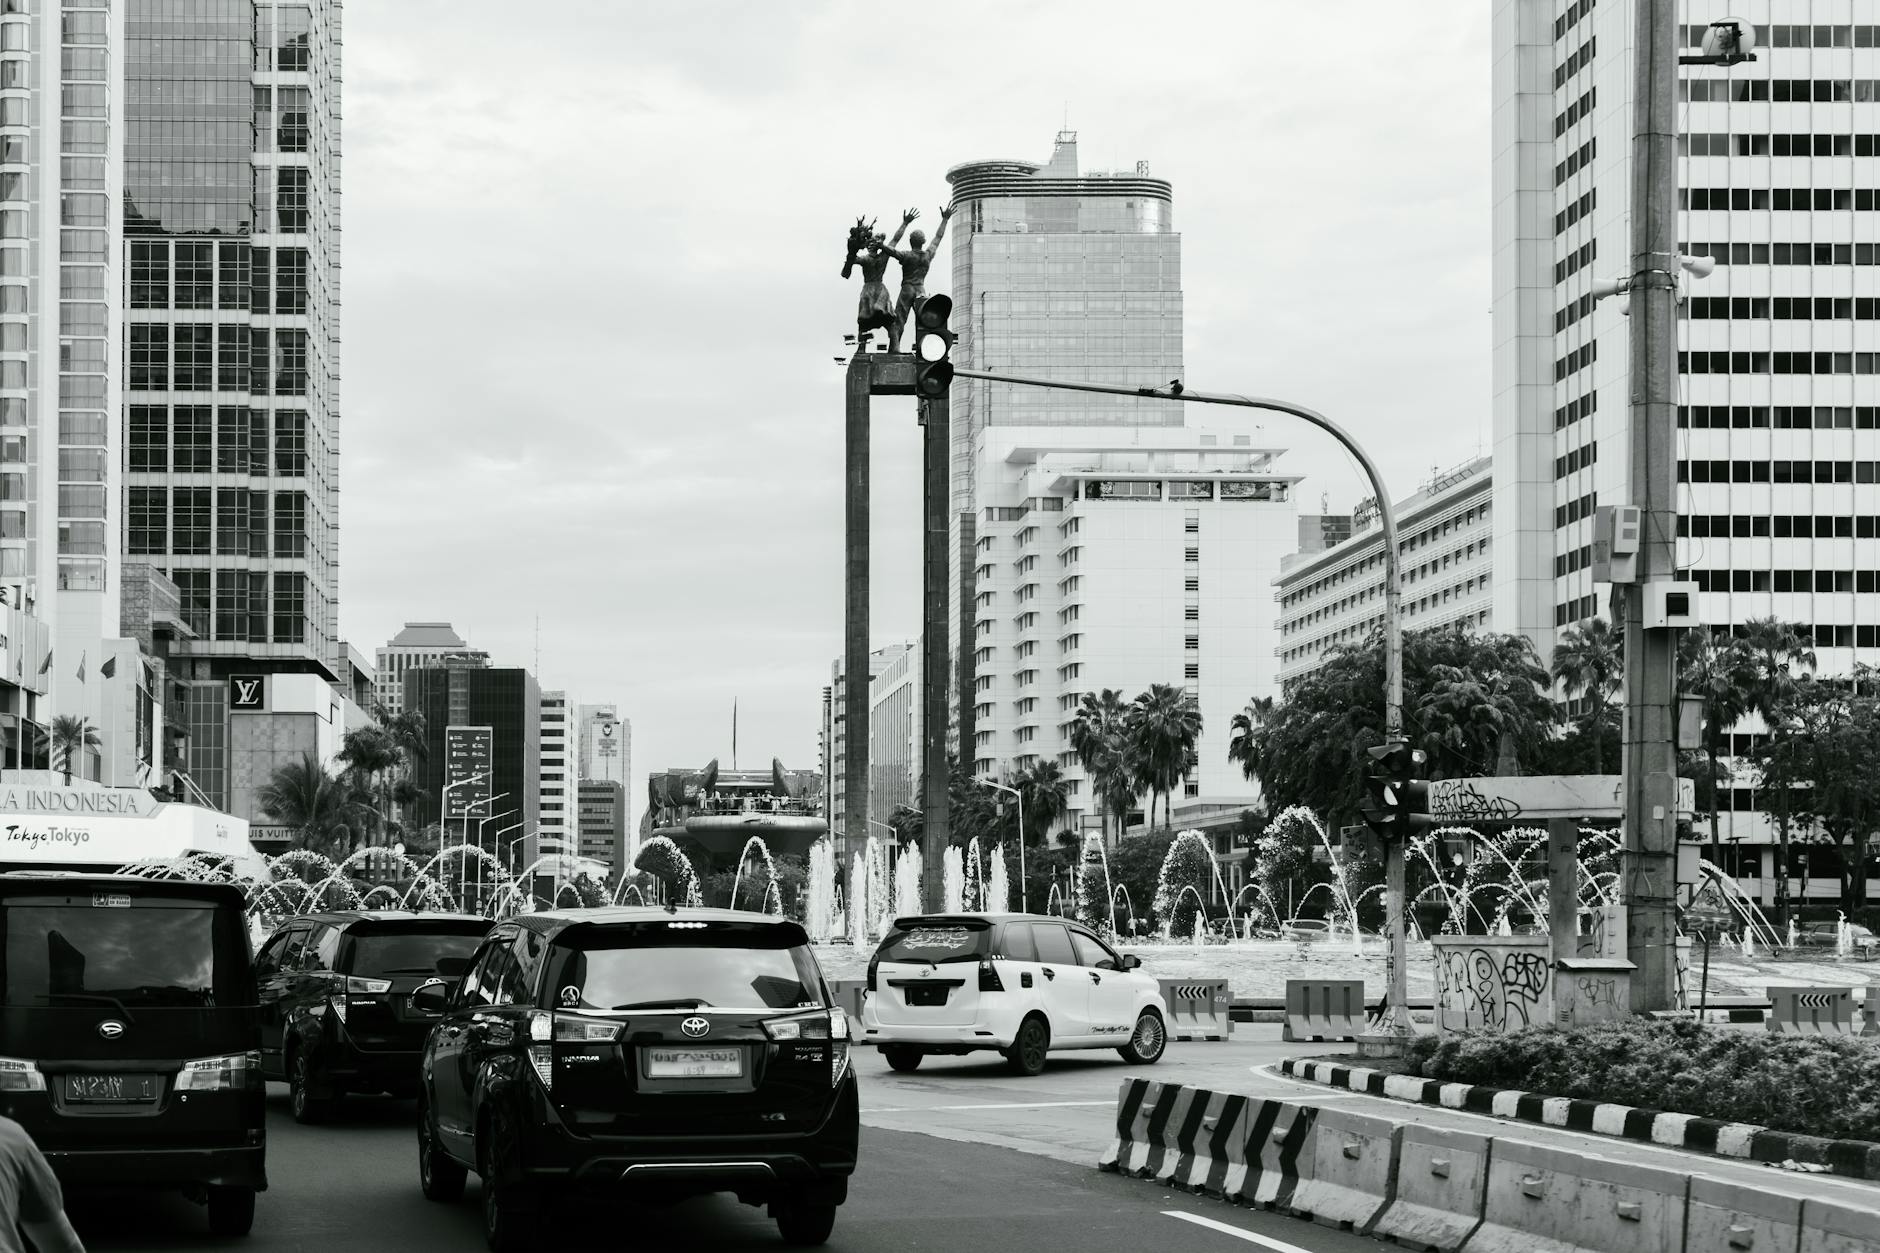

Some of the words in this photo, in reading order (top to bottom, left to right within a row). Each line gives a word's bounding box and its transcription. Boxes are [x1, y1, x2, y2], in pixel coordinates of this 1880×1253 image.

[0, 789, 19, 810] A
[26, 790, 139, 813] INDONESIA
[48, 827, 90, 846] Tokyo
